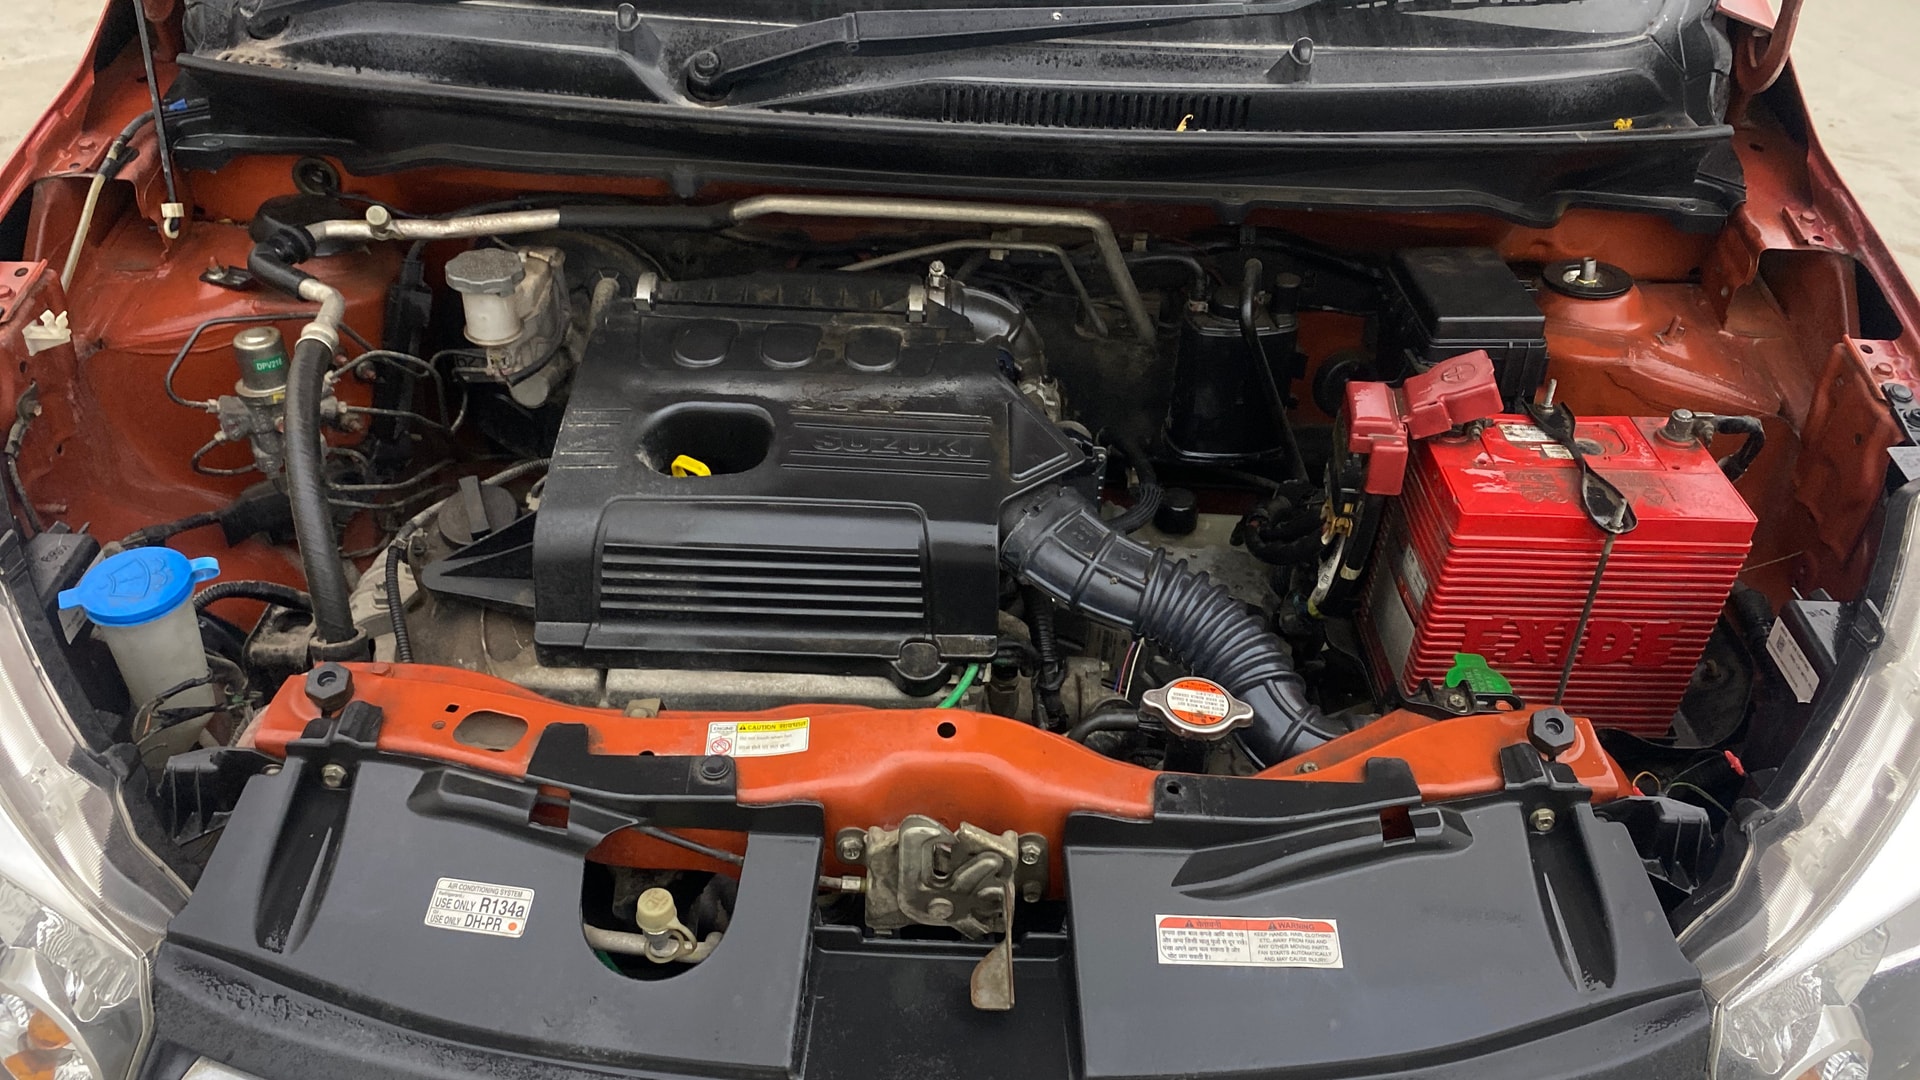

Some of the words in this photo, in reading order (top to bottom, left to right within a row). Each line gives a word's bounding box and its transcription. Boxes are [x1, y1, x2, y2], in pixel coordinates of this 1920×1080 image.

[812, 434, 972, 458] SUZUKI
[1461, 618, 1682, 666] EXIDE
[459, 884, 498, 894] CONDITIONING
[435, 897, 451, 908] USE
[454, 899, 476, 911] ONLY
[479, 898, 524, 917] R134a
[430, 914, 443, 923] USE
[444, 916, 461, 925] ONLY
[465, 914, 502, 930] DH-PR
